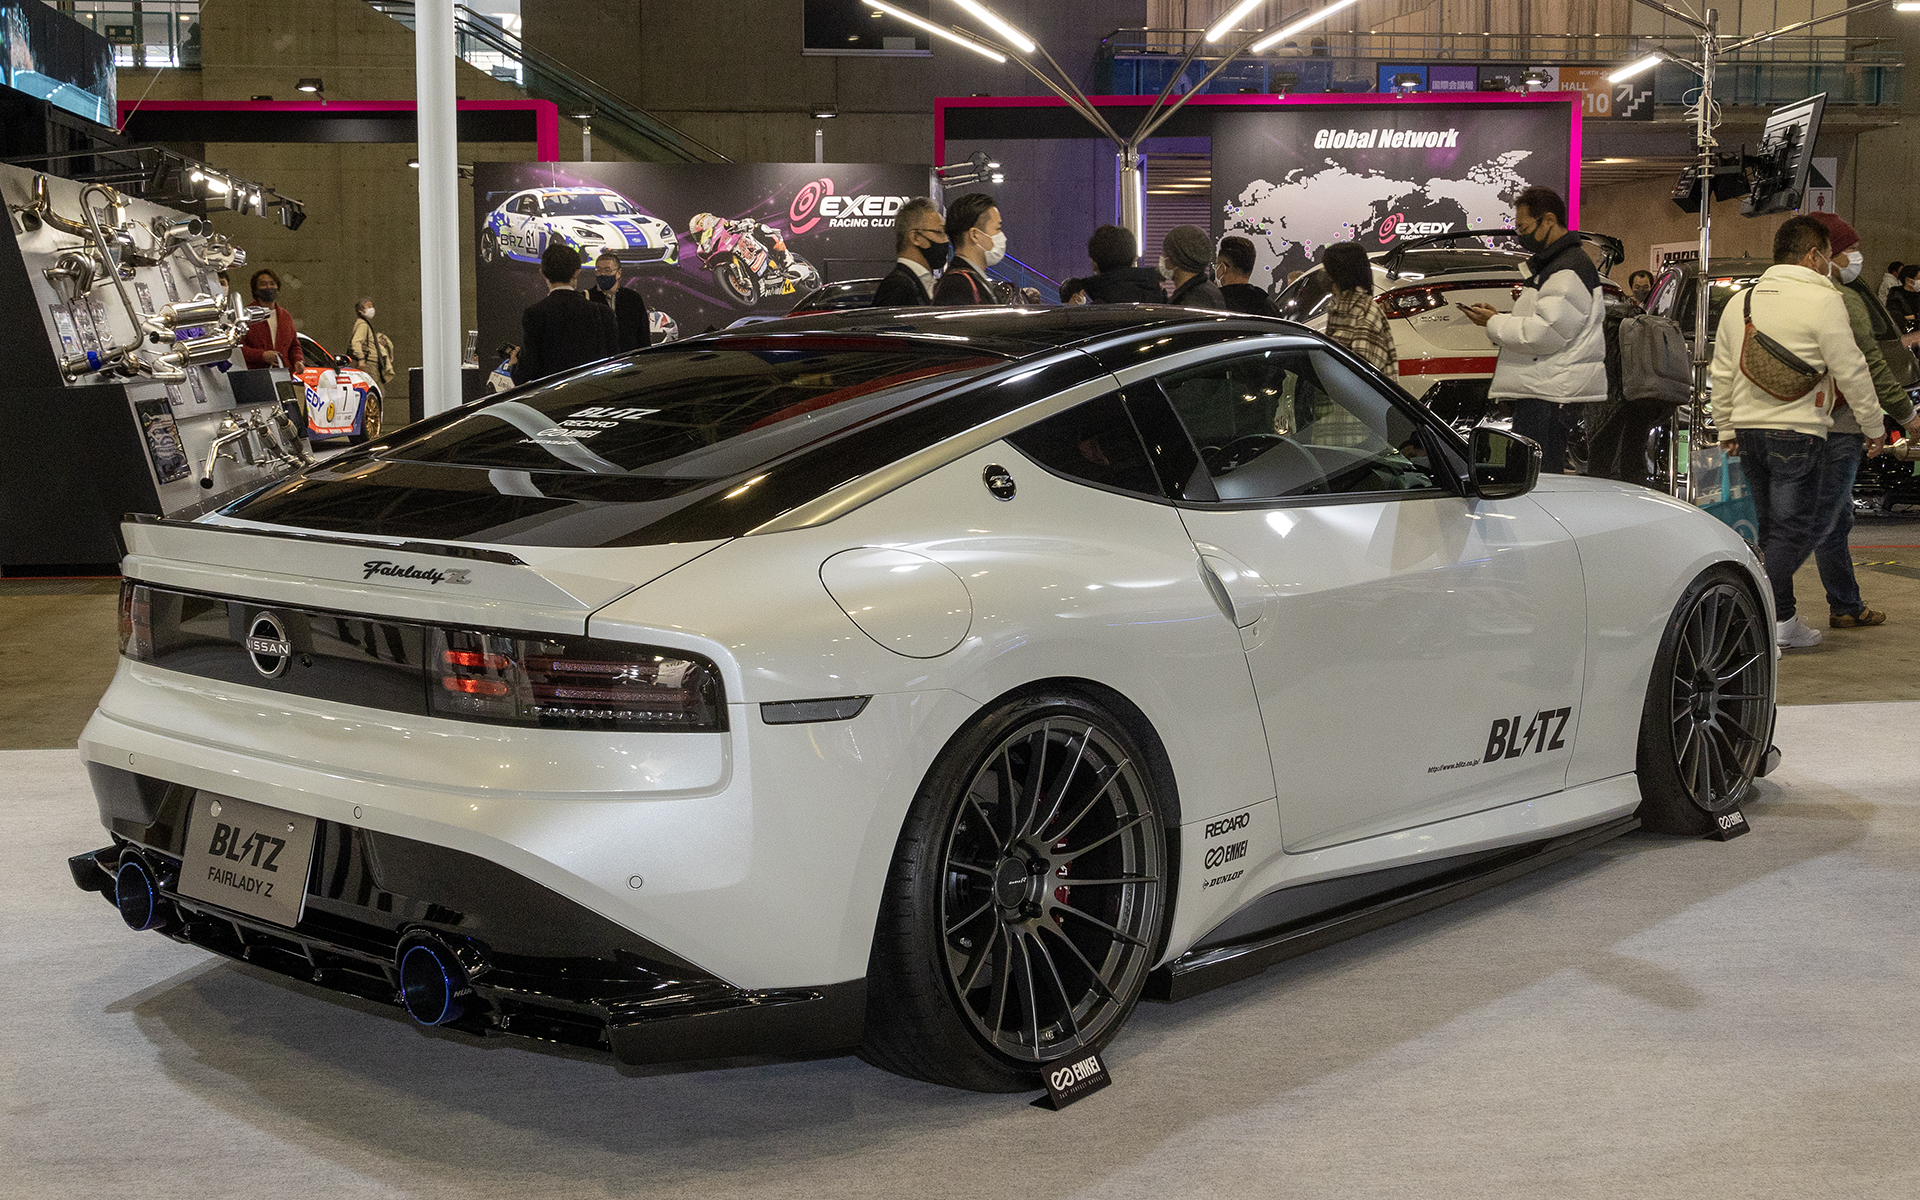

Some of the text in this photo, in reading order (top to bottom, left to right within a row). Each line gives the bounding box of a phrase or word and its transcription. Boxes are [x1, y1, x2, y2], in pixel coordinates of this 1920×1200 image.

[1432, 80, 1474, 90] 国際会議場
[1561, 82, 1588, 91] HALL
[1313, 128, 1459, 149] Global Network
[828, 218, 896, 228] RACING CLUT
[1395, 222, 1454, 235] EXEDY
[501, 233, 525, 248] BRZ
[525, 229, 536, 248] 61
[306, 387, 325, 412] EDY
[342, 385, 348, 412] 7
[567, 406, 661, 420] BLITZ
[557, 419, 619, 429] RECARO
[363, 560, 445, 585] Fairlady
[246, 638, 289, 654] NISSAN
[1483, 706, 1571, 764] BLITZ
[1204, 812, 1250, 839] RECARO
[208, 822, 286, 873] BLITZ
[1224, 839, 1249, 863] ENKEI
[207, 866, 274, 898] FAIRLADY Z
[1208, 870, 1244, 887] DUNLOP
[1071, 1055, 1101, 1081] ENKEI
